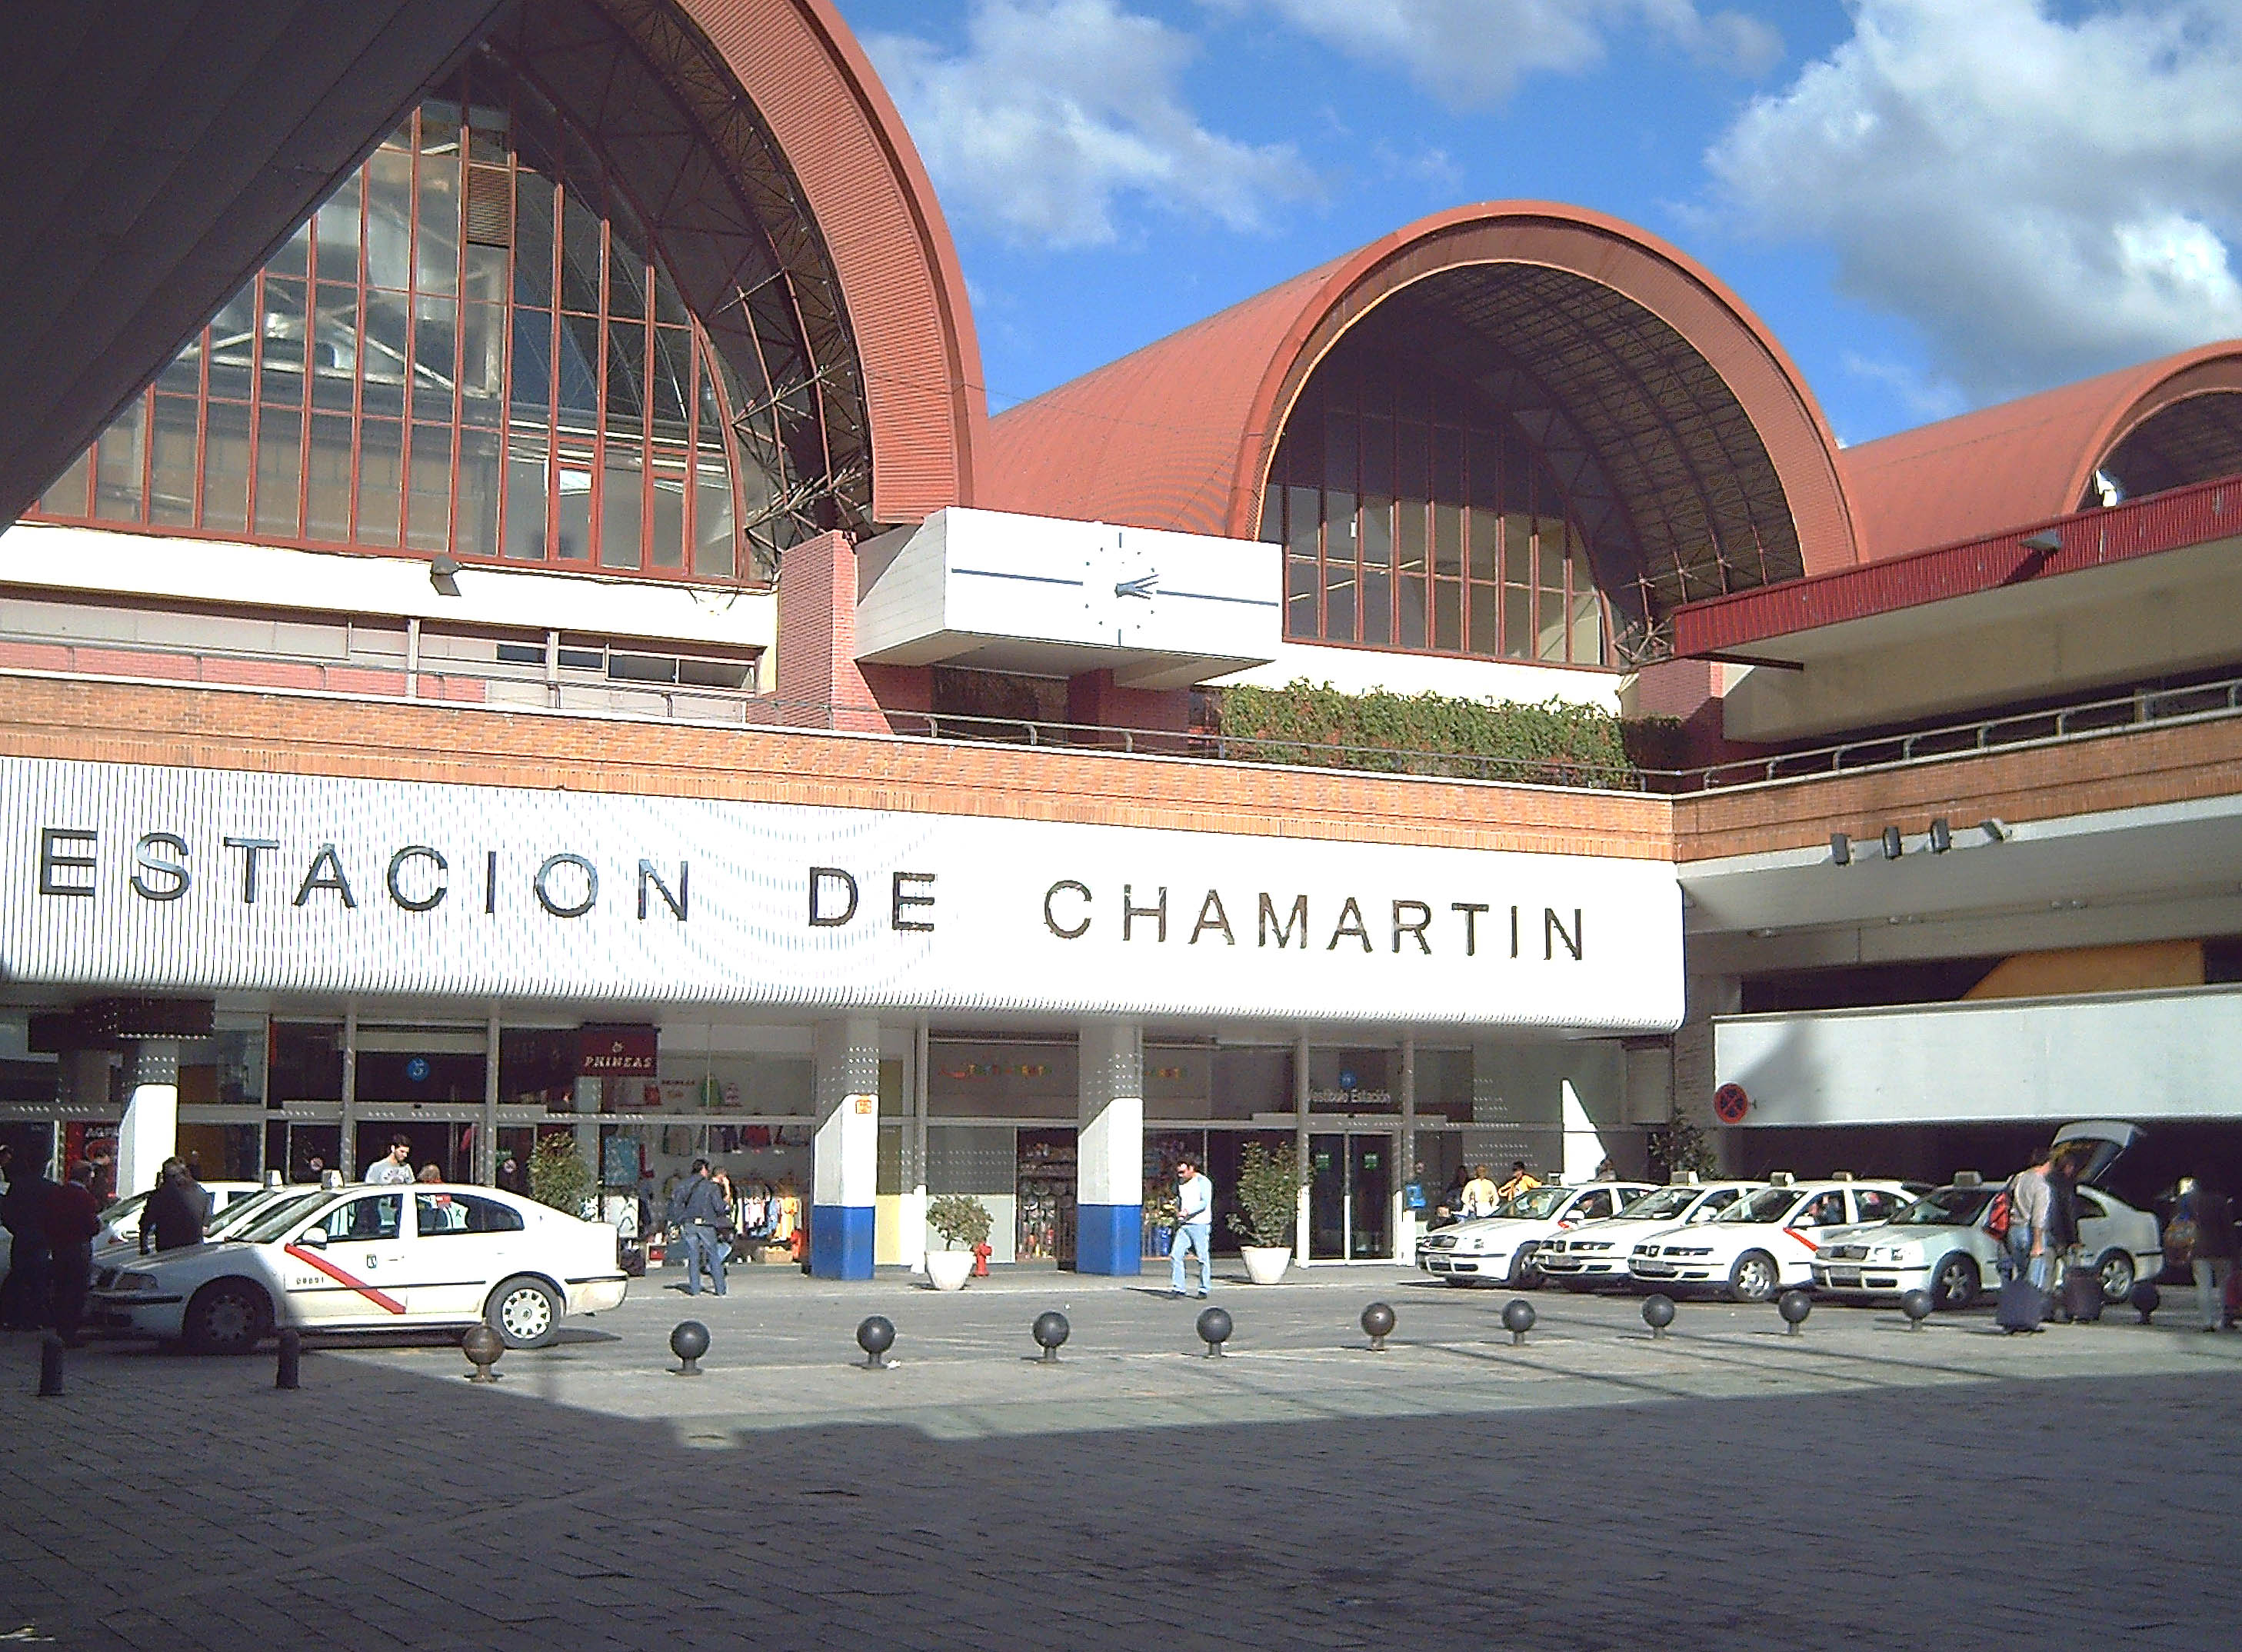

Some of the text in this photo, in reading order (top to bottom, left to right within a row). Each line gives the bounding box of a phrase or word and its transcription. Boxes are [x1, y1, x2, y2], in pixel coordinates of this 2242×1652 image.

[40, 827, 1583, 961] ESTACION DE CHAMARTIN
[584, 1056, 653, 1068] PHINEAS
